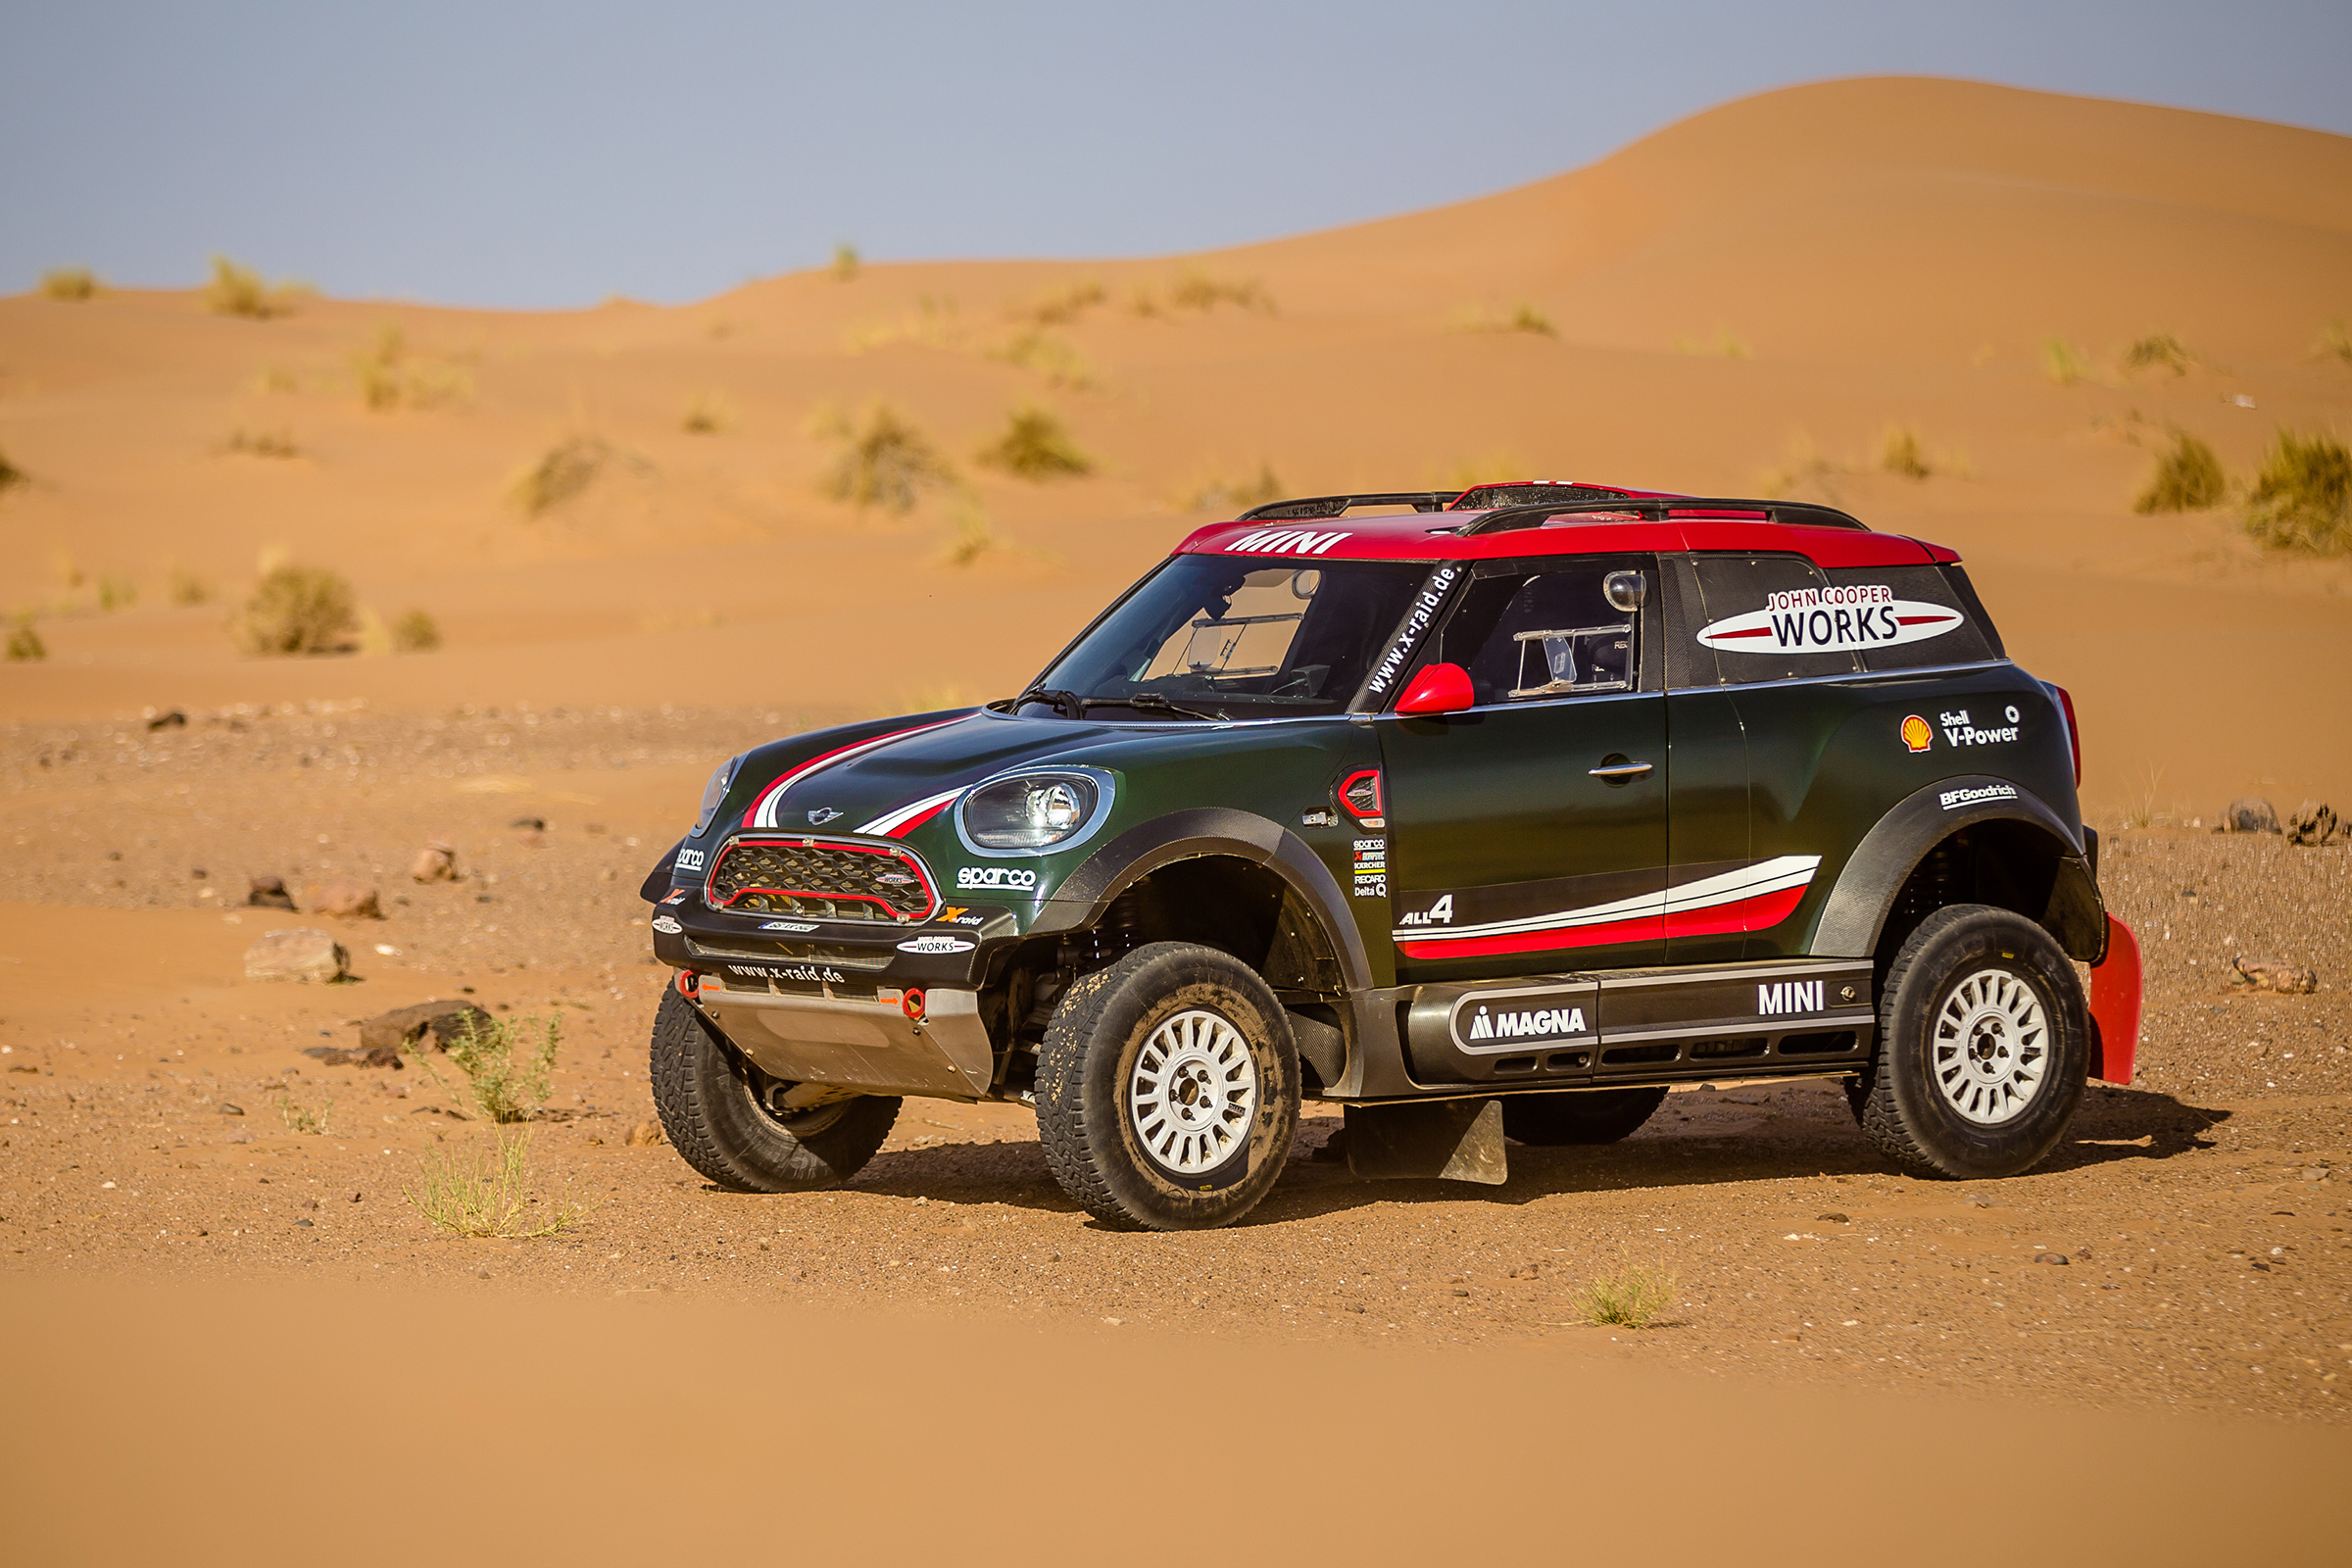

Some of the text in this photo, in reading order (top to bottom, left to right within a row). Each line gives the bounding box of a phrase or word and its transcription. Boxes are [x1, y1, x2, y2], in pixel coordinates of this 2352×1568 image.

[1224, 530, 1353, 555] MINI
[1768, 587, 1891, 612] JOHN COOPER
[1368, 567, 1455, 694] www.x-raid.de
[1771, 606, 1898, 648] WORKS
[1940, 710, 1971, 727] Shell
[1943, 726, 2019, 747] V-Power
[1939, 785, 2017, 807] BFGoodrich
[1353, 839, 1385, 850] sparco
[957, 866, 1037, 890] sparco
[1354, 874, 1386, 884] RECARO
[1354, 883, 1387, 898] Delta Q
[935, 906, 984, 926] X-raid
[1398, 894, 1453, 925] ALL4
[917, 942, 955, 952] WORKS
[727, 964, 846, 984] www.x-raid.de
[1758, 980, 1824, 1015] MINI
[1495, 1007, 1587, 1038] MAGNA
